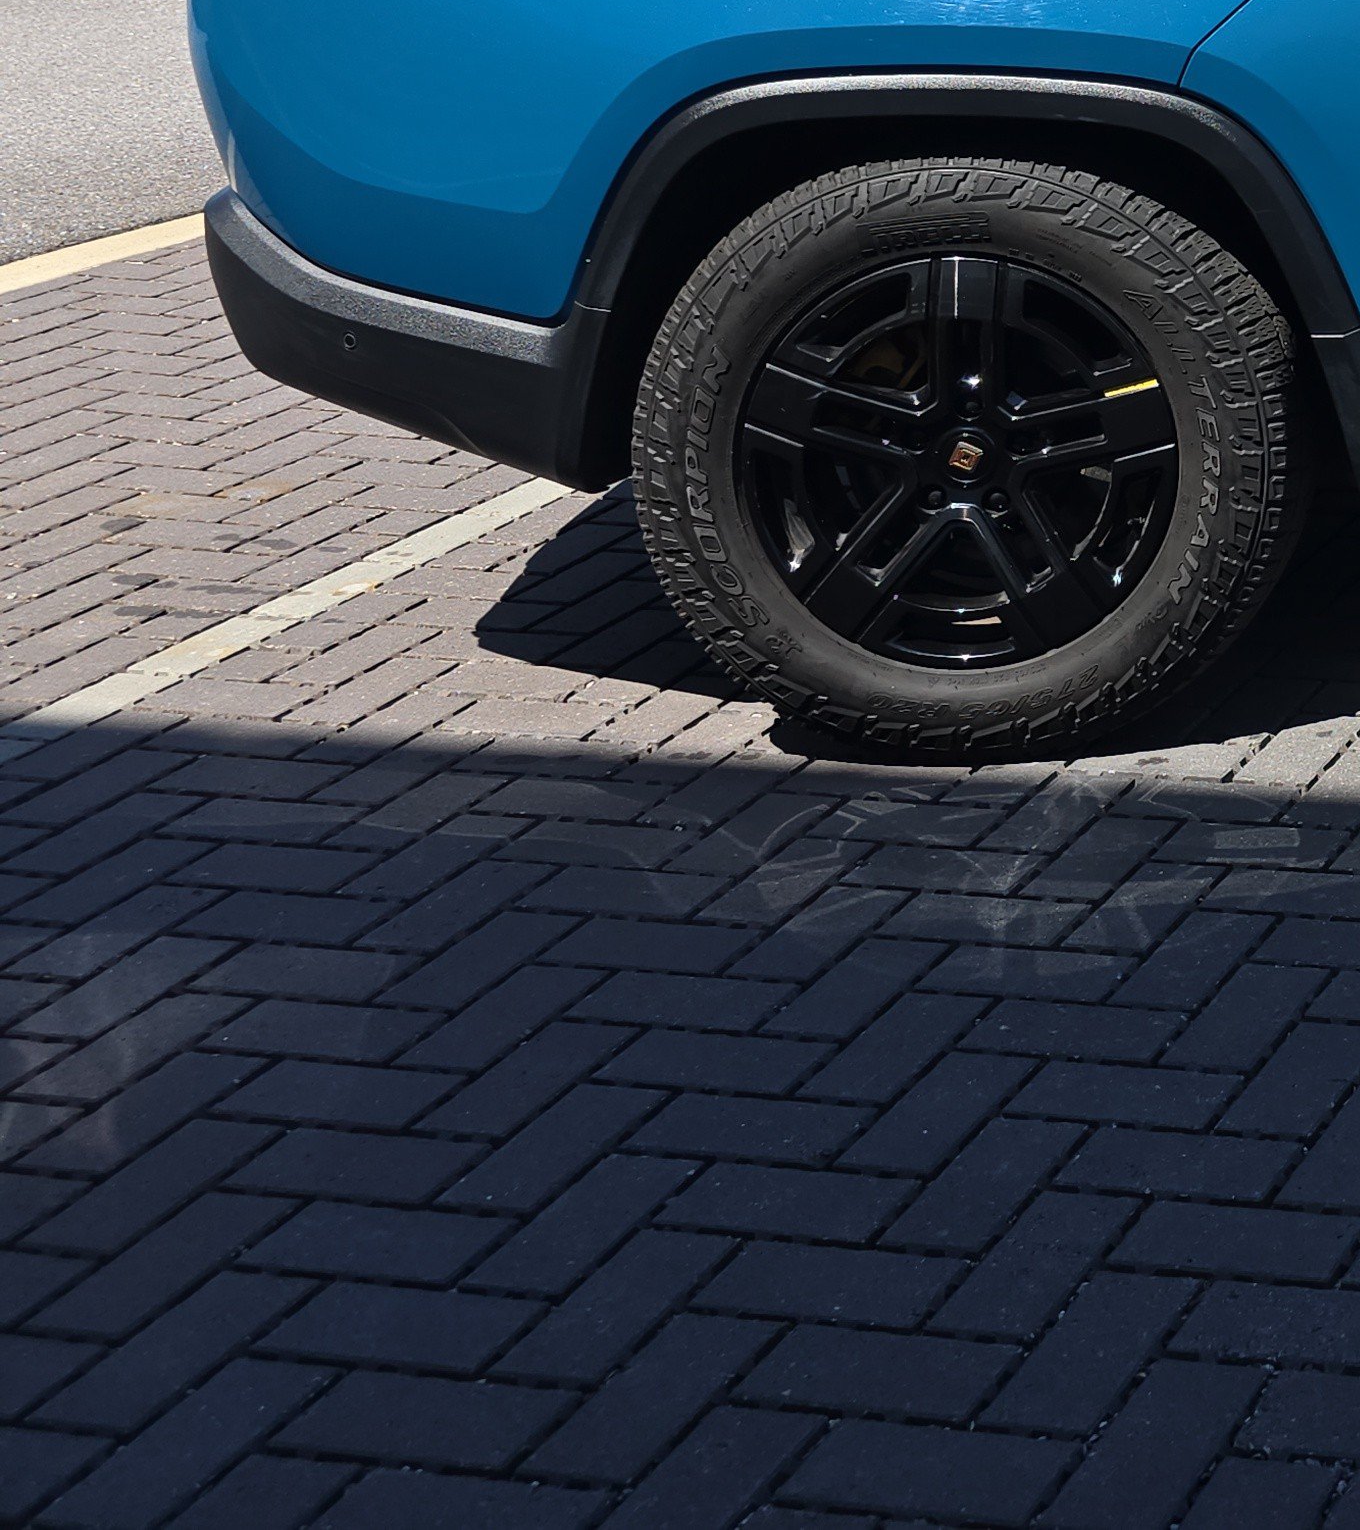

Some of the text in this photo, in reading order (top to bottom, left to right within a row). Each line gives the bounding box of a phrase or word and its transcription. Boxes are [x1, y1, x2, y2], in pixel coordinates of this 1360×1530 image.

[683, 345, 771, 629] SCORPION
[1122, 289, 1198, 375] ALL
[1166, 374, 1222, 607] TERRAIN
